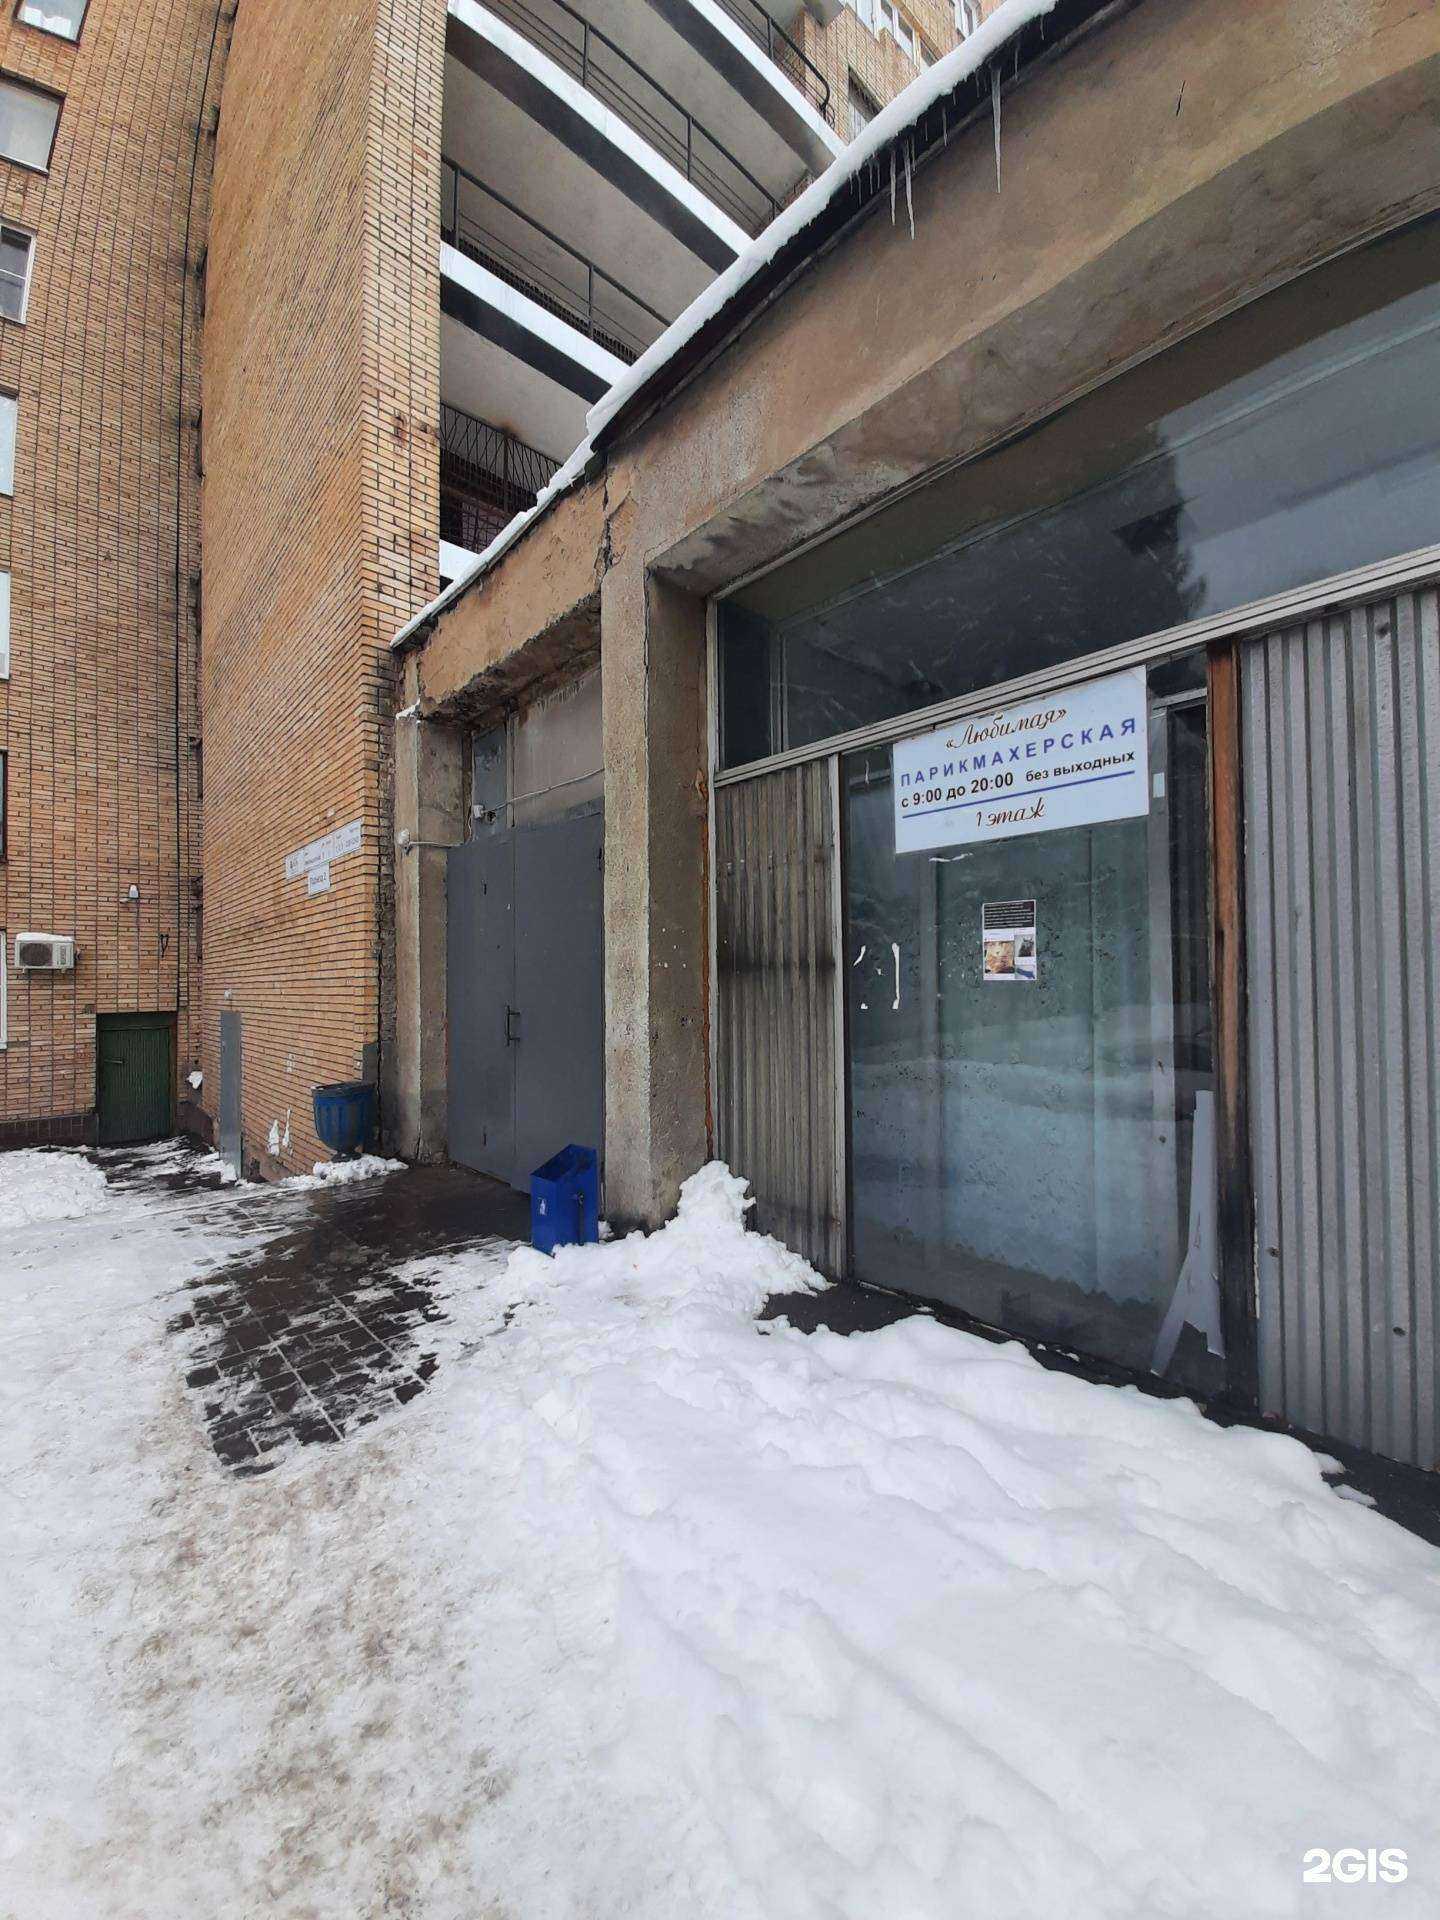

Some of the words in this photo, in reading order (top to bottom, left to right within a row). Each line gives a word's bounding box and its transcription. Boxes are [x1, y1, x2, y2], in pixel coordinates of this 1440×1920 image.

[900, 718, 1136, 787] ПАРИКМАХЕРСКАЯ
[945, 707, 1067, 749] «Любимая»
[901, 797, 909, 808] с
[913, 787, 942, 806] 9:00
[946, 785, 966, 801] до
[971, 772, 1014, 794] 20:00
[1025, 769, 1049, 782] без
[1053, 751, 1136, 777] выходных
[975, 810, 982, 827] 1
[986, 797, 1045, 827] этаж
